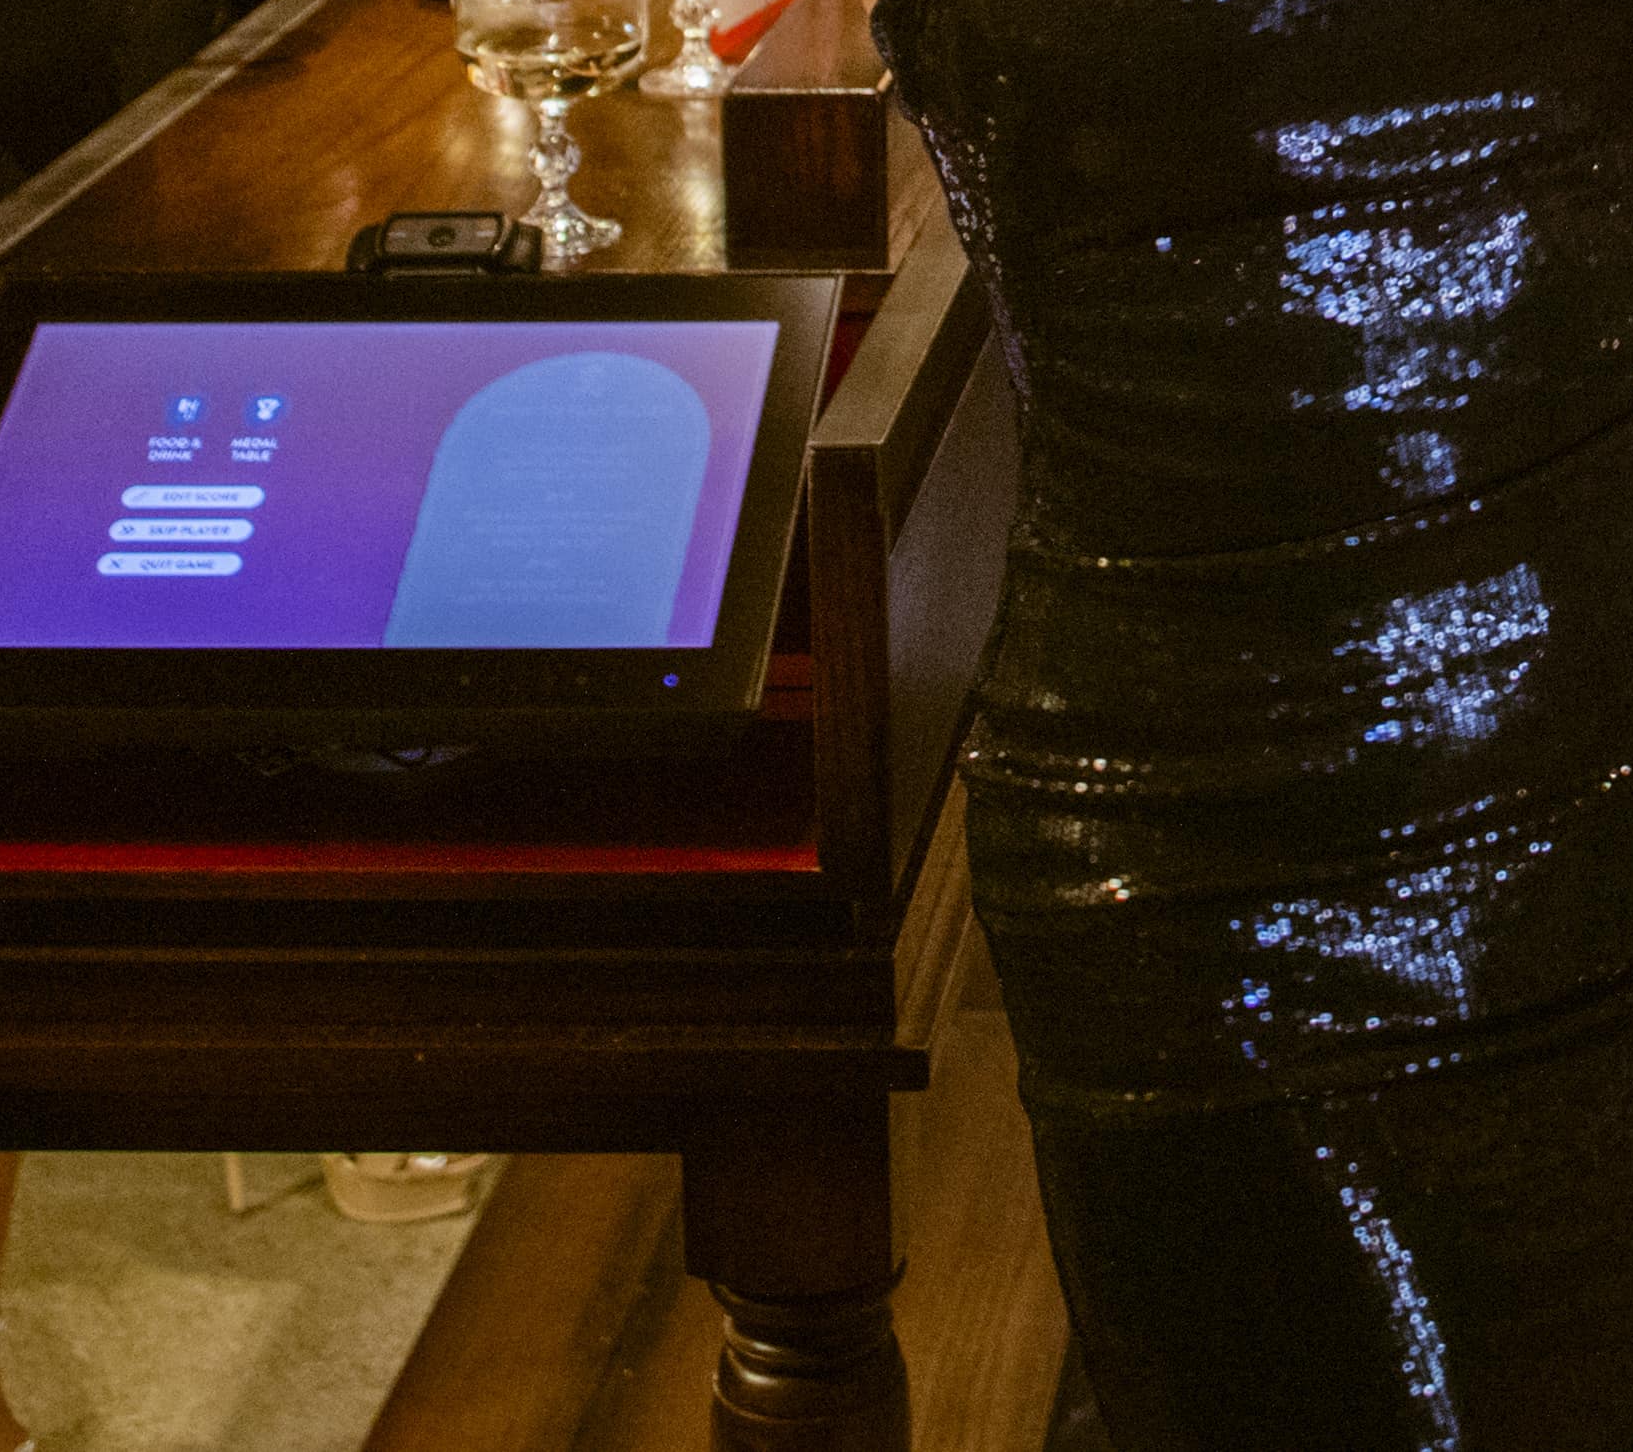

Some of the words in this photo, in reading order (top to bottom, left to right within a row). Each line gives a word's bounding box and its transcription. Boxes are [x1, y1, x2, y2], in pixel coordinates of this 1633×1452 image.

[148, 436, 188, 450] FOOD
[230, 436, 278, 450] MEDAL
[147, 450, 193, 462] DRINK
[195, 491, 239, 503] SCORE
[149, 524, 178, 536] SKIP
[182, 524, 232, 536] PLAYER
[140, 559, 173, 571] QUIT
[176, 559, 215, 571] GAME
